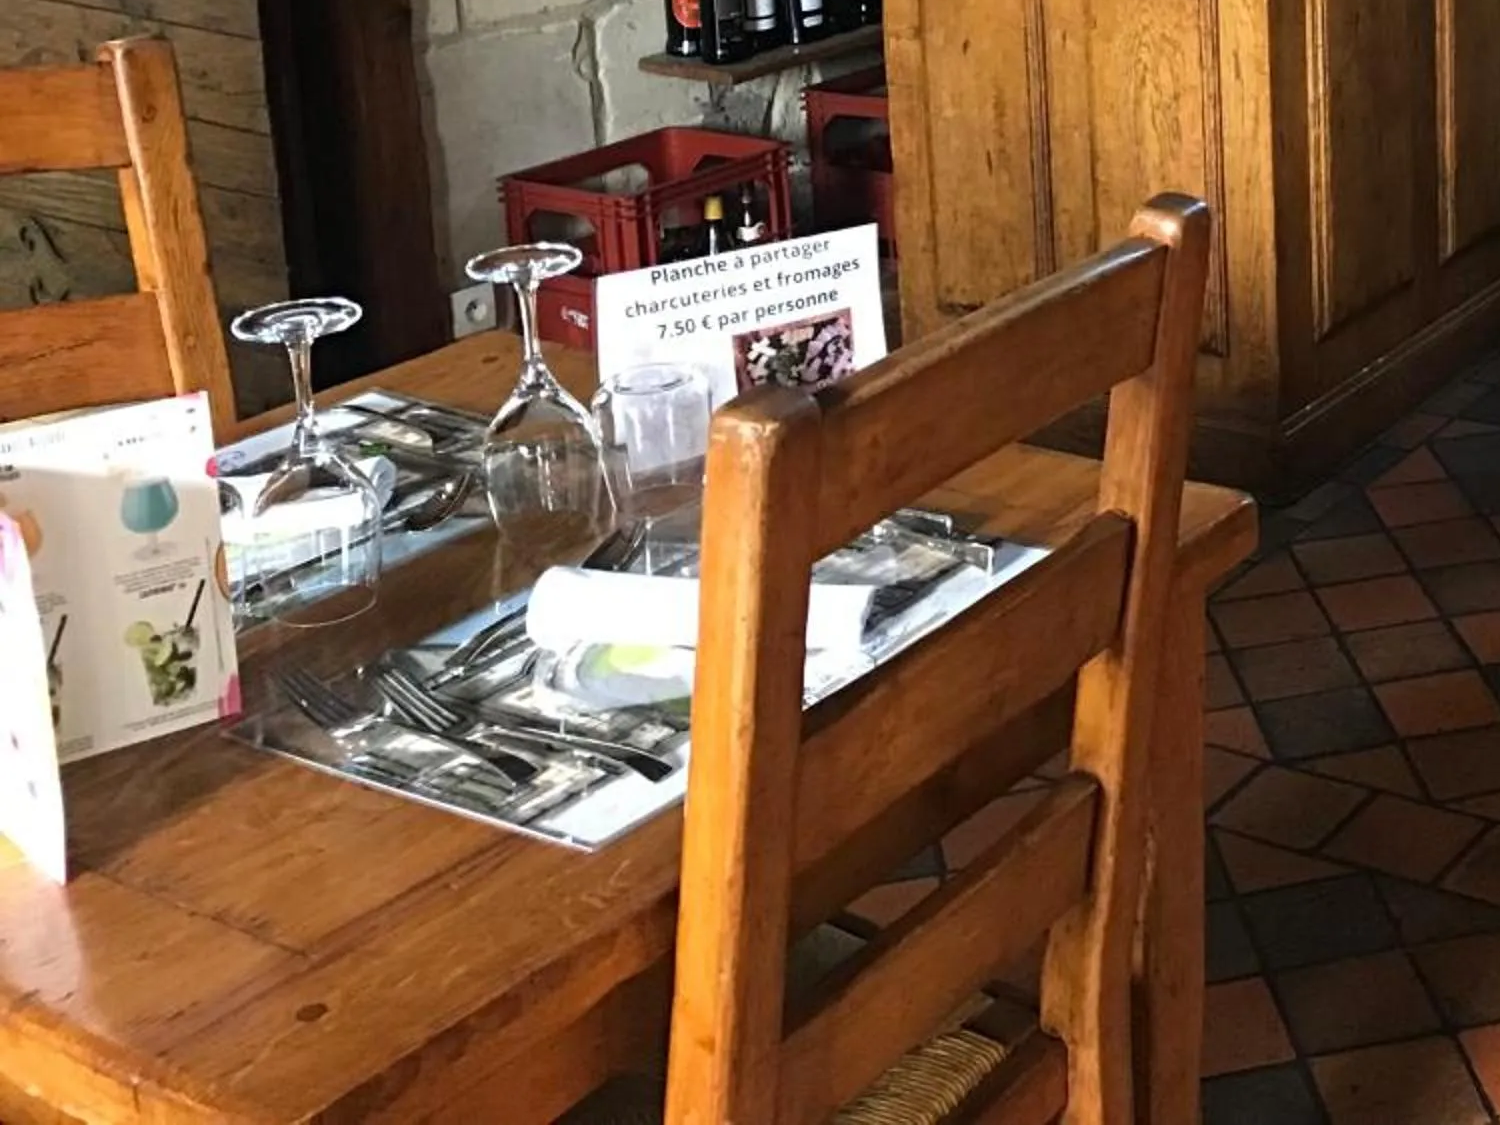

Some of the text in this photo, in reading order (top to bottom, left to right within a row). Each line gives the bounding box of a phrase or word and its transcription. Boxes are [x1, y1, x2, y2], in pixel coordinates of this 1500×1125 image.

[624, 282, 748, 318] charcuteries
[753, 277, 772, 293] et
[777, 256, 861, 288] fromages
[651, 238, 831, 286] Planche à partager
[657, 288, 839, 339] 7.50 € par personne
